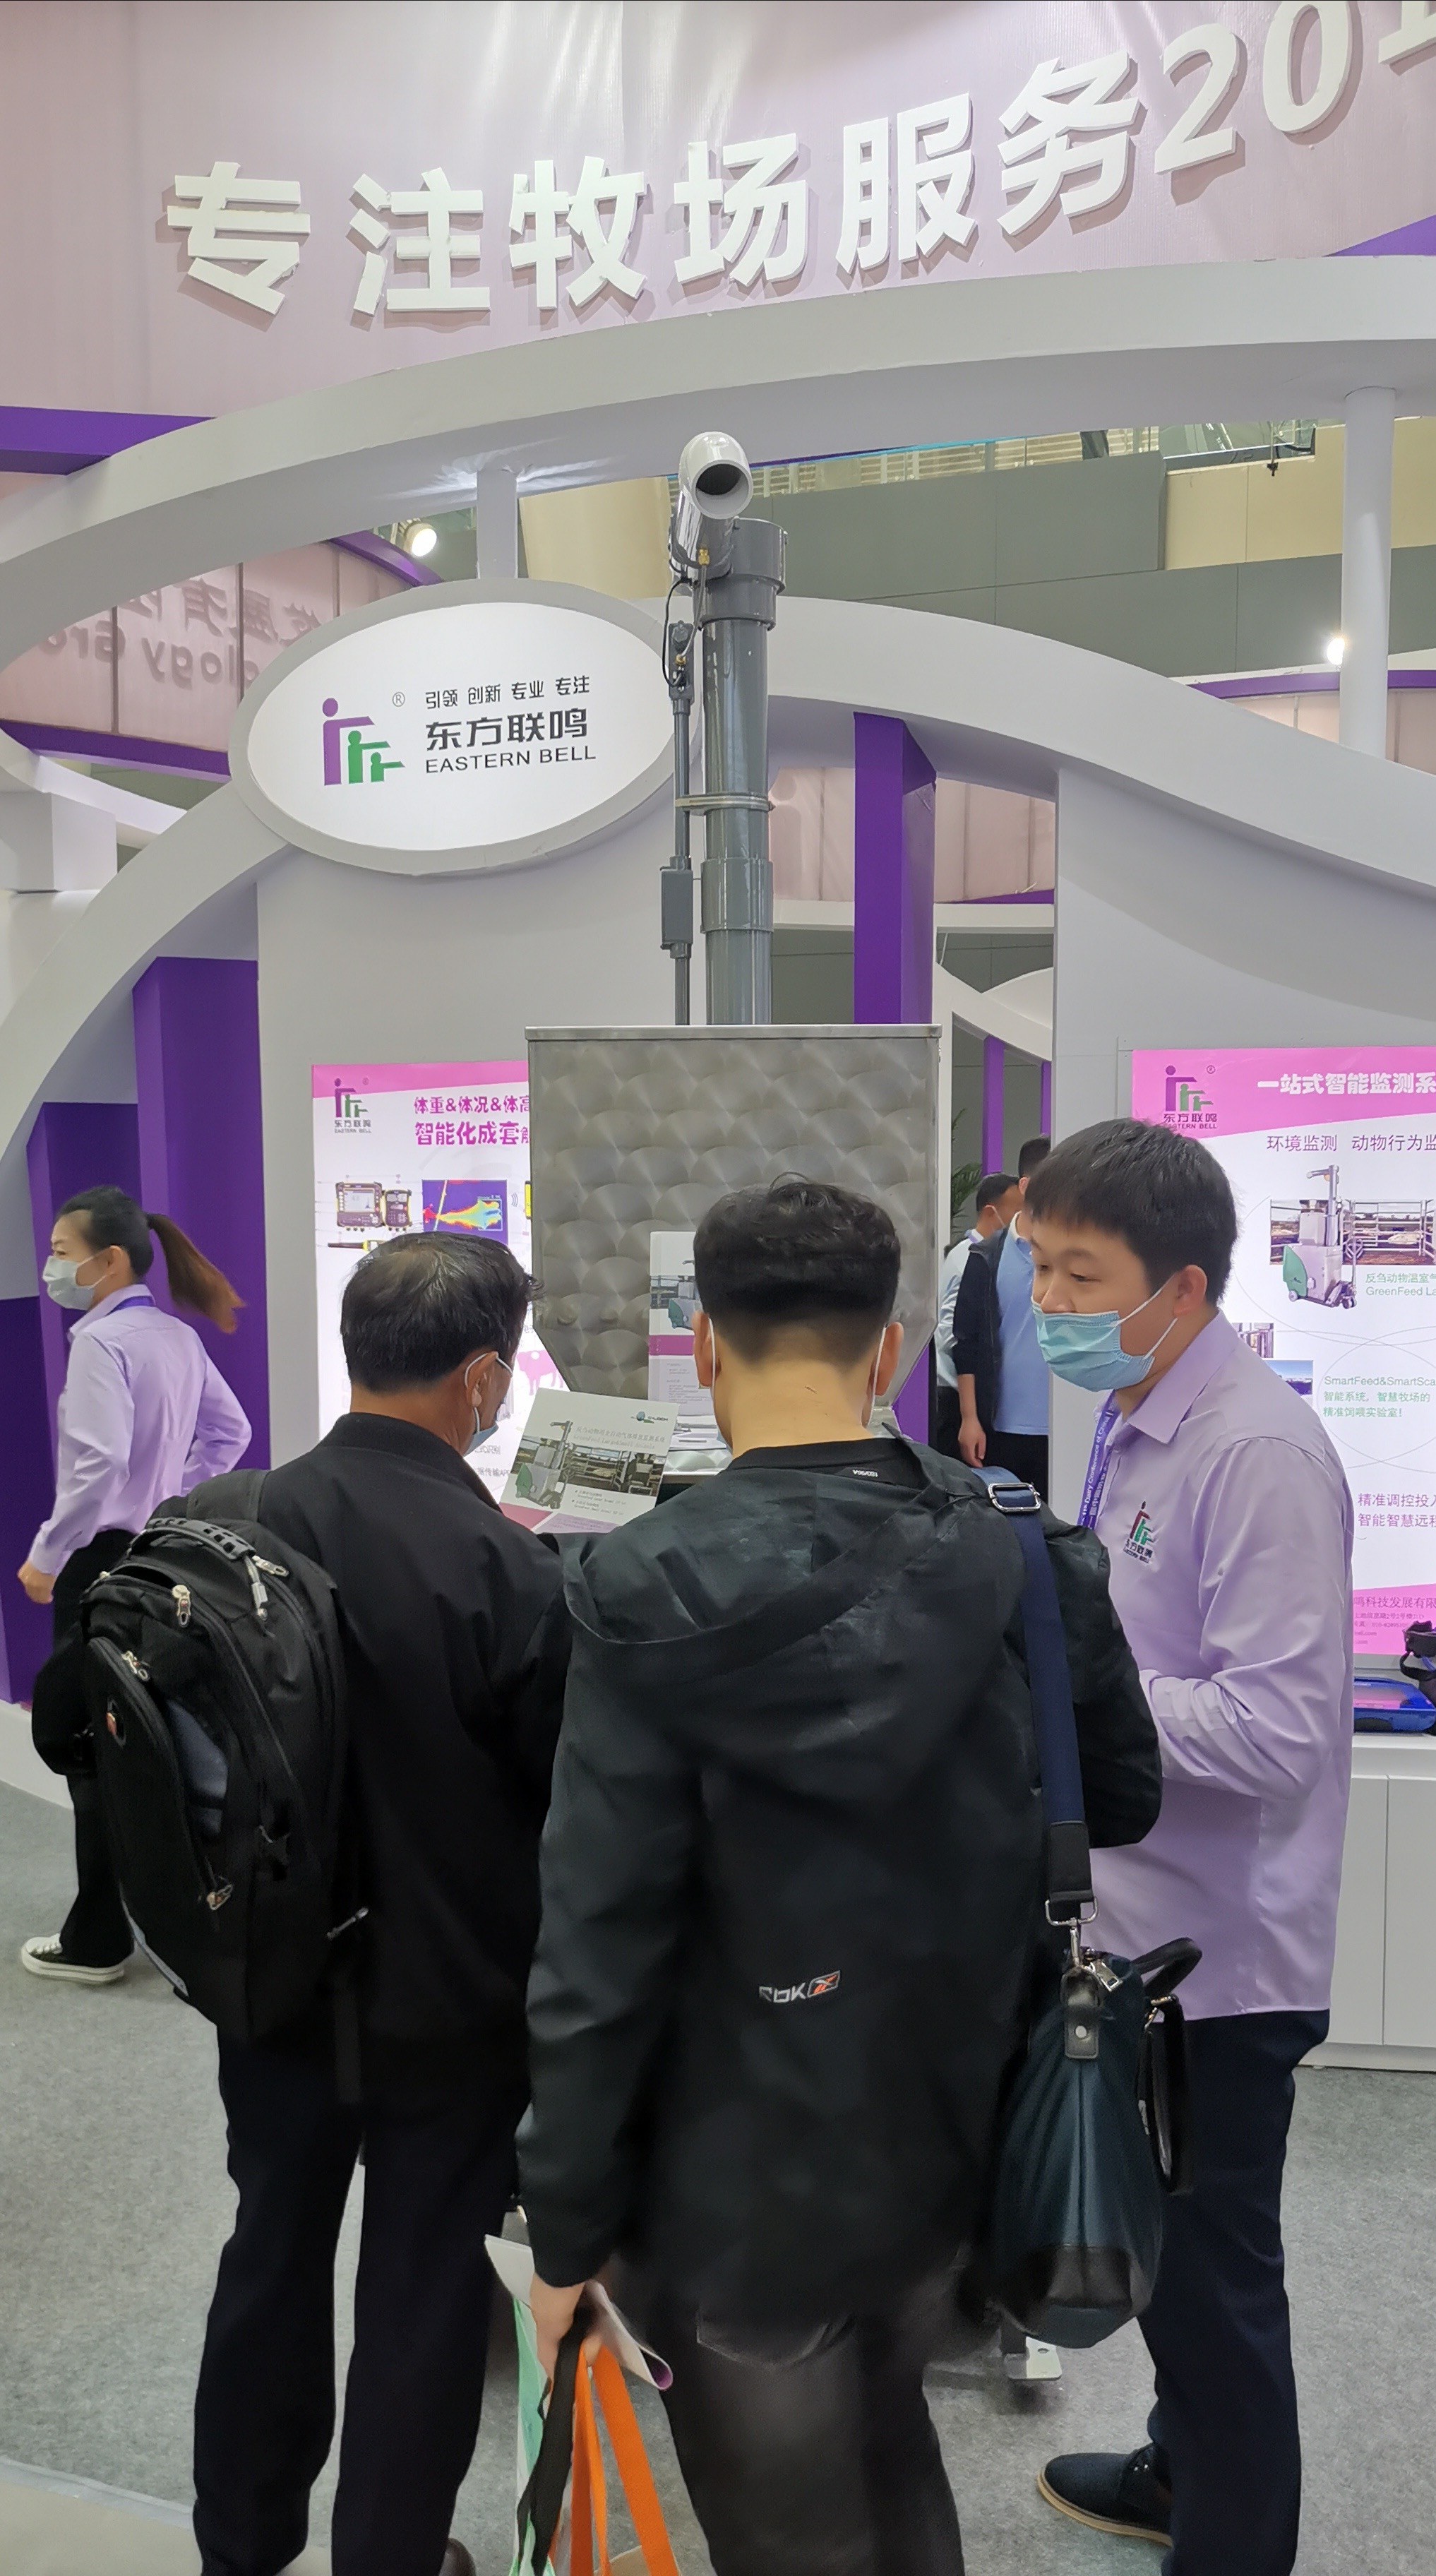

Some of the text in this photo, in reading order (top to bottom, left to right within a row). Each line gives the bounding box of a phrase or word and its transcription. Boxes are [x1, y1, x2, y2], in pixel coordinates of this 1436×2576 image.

[425, 675, 590, 709] 引领 创新 专业 专注
[426, 708, 587, 751] 东方联鸣
[426, 746, 597, 774] EASTERN BELL
[1163, 1113, 1217, 1123] 东方联鸣
[1267, 1133, 1337, 1152] 环境监测
[1365, 1286, 1423, 1296] GreenFeed
[1088, 1444, 1100, 1484] Conference
